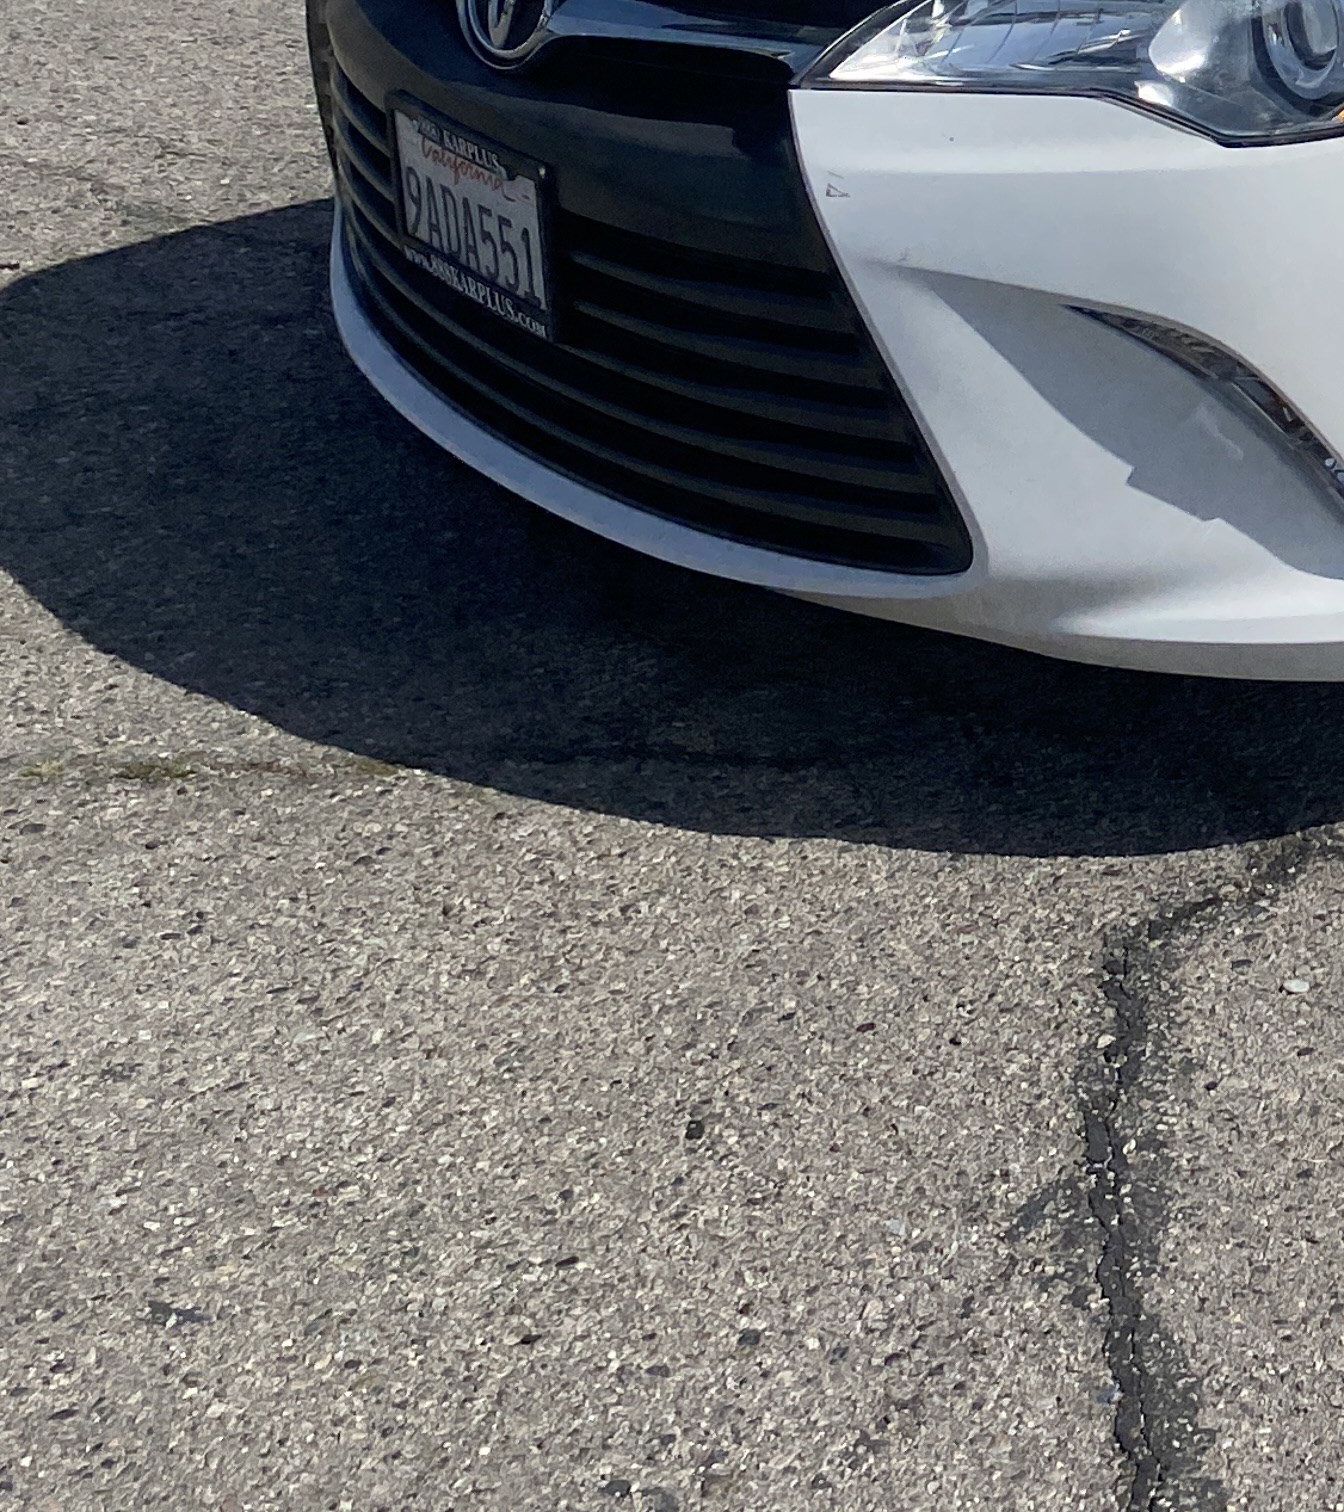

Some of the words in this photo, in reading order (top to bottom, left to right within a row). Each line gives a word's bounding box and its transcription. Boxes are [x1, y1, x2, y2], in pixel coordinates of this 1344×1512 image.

[419, 140, 508, 194] California
[442, 128, 501, 169] KARPLUS
[405, 165, 542, 306] 9ADA551
